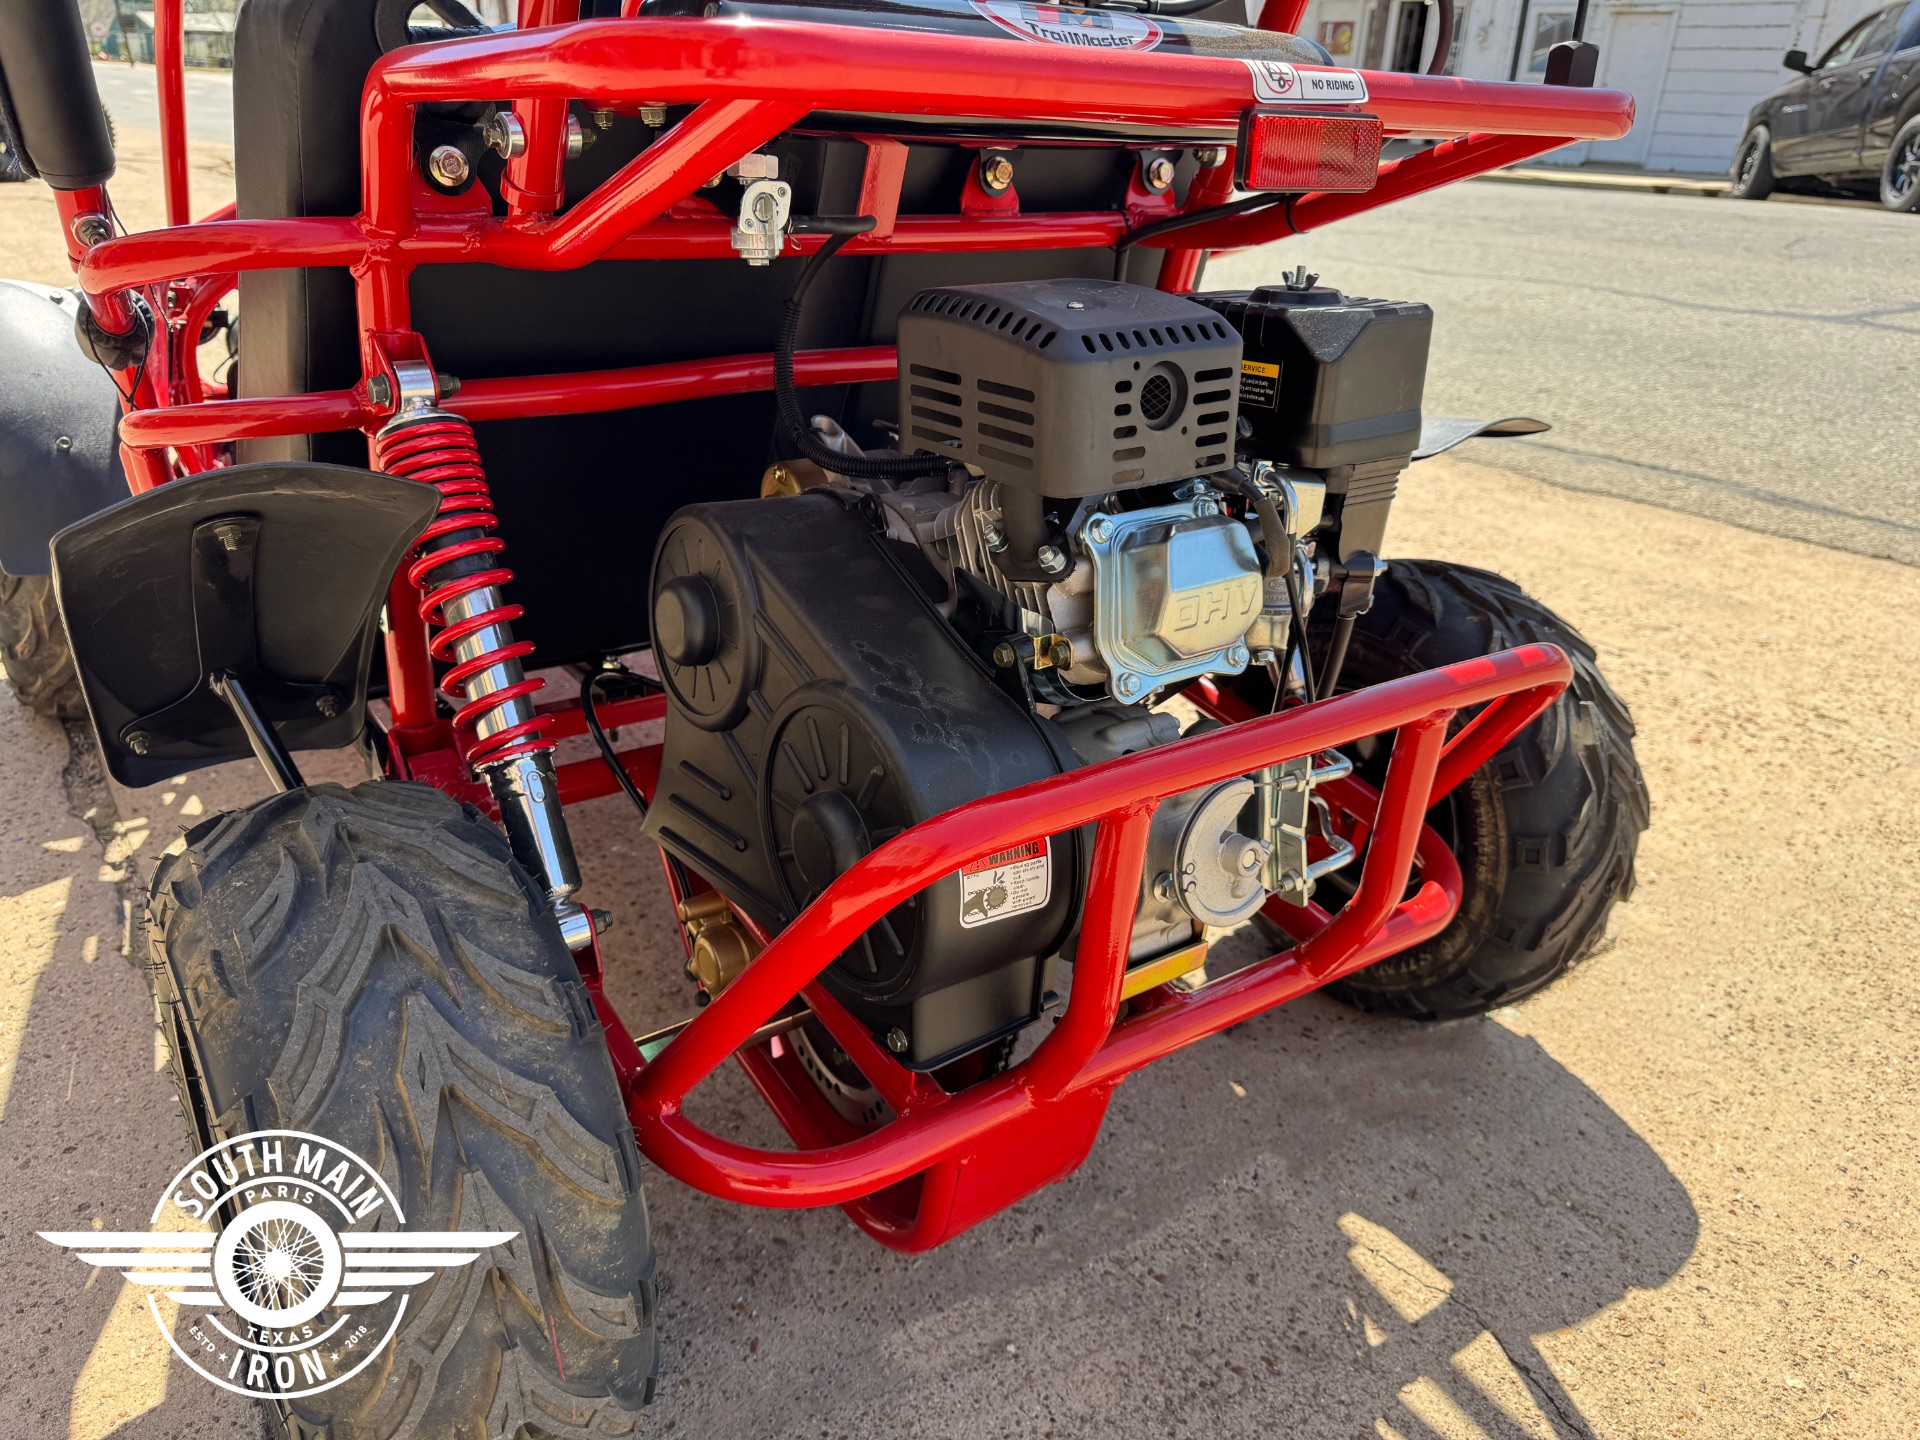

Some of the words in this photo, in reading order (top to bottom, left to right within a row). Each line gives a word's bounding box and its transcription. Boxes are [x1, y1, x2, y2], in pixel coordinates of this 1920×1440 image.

[1024, 21, 1136, 48] TrailMaster
[1311, 79, 1324, 90] NO
[1326, 79, 1355, 91] RIDING
[1174, 580, 1258, 632] OHV
[988, 841, 1039, 866] WARNING
